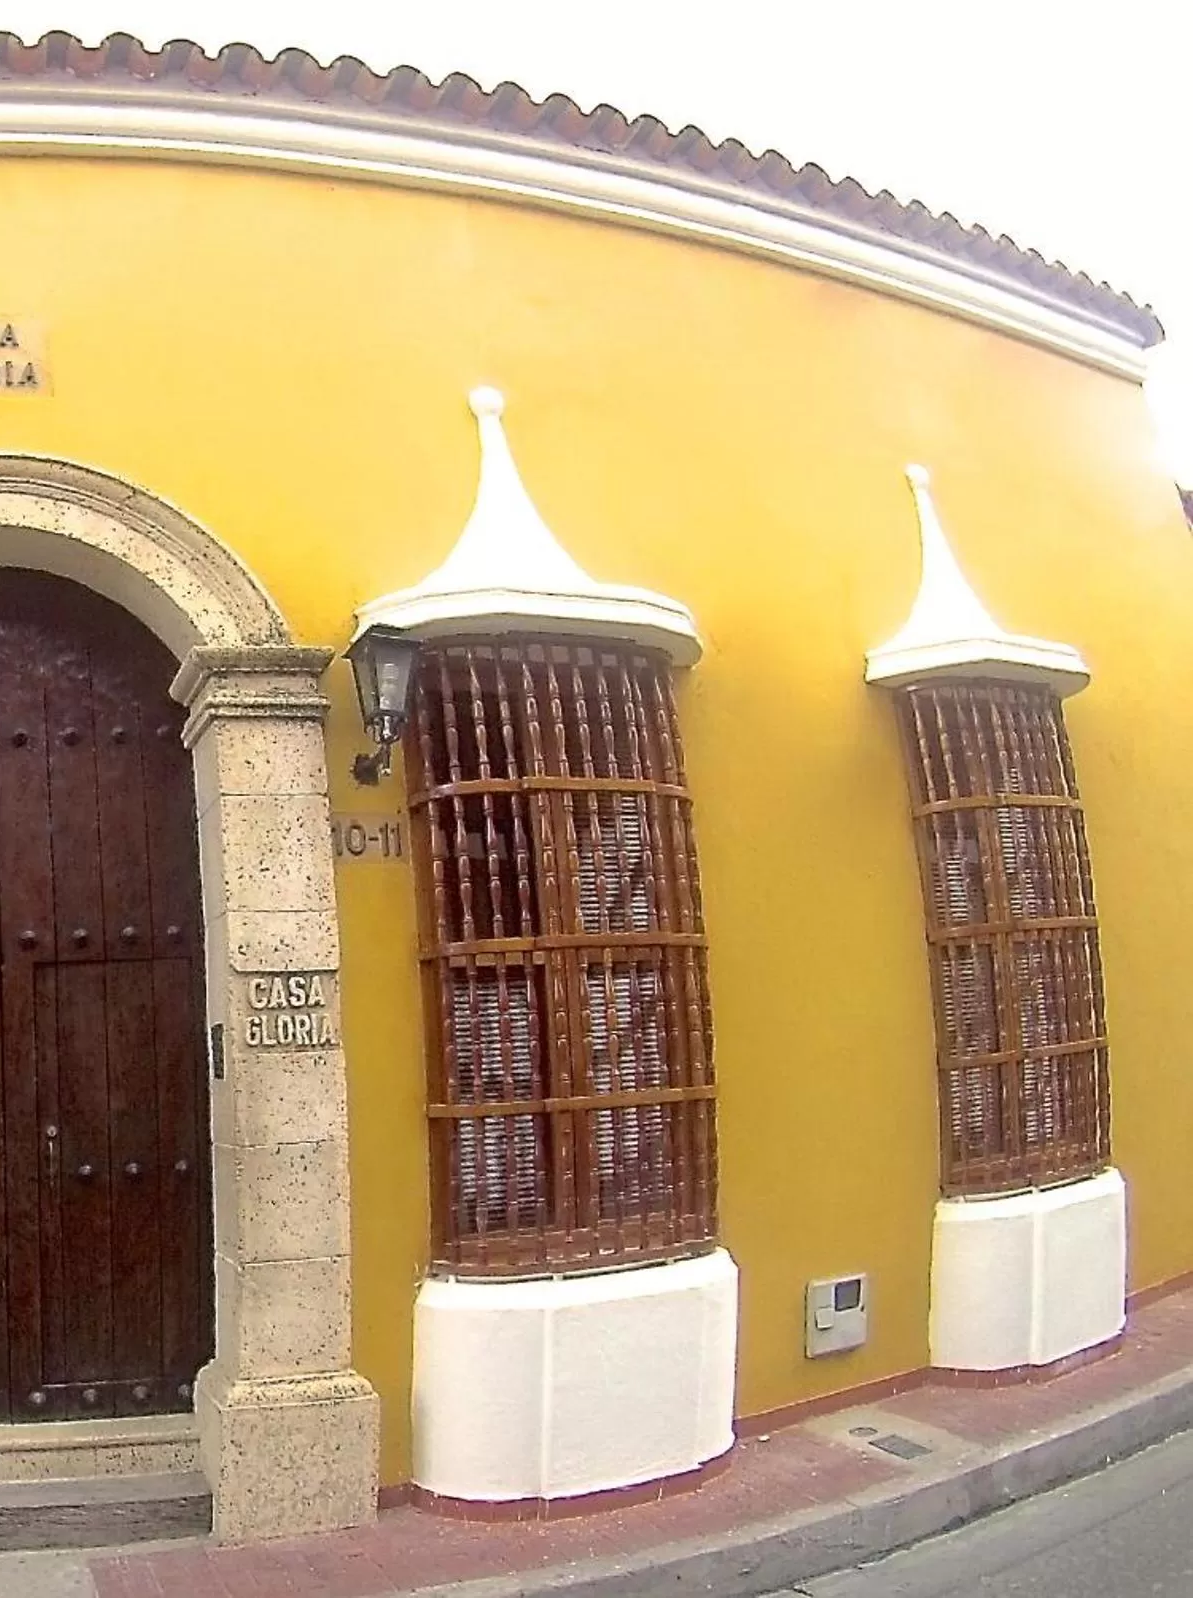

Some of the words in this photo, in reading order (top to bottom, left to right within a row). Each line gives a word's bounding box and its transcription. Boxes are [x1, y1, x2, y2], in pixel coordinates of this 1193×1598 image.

[331, 821, 402, 857] 10-11
[248, 975, 326, 1009] CASA
[245, 1014, 340, 1048] GLORIA
